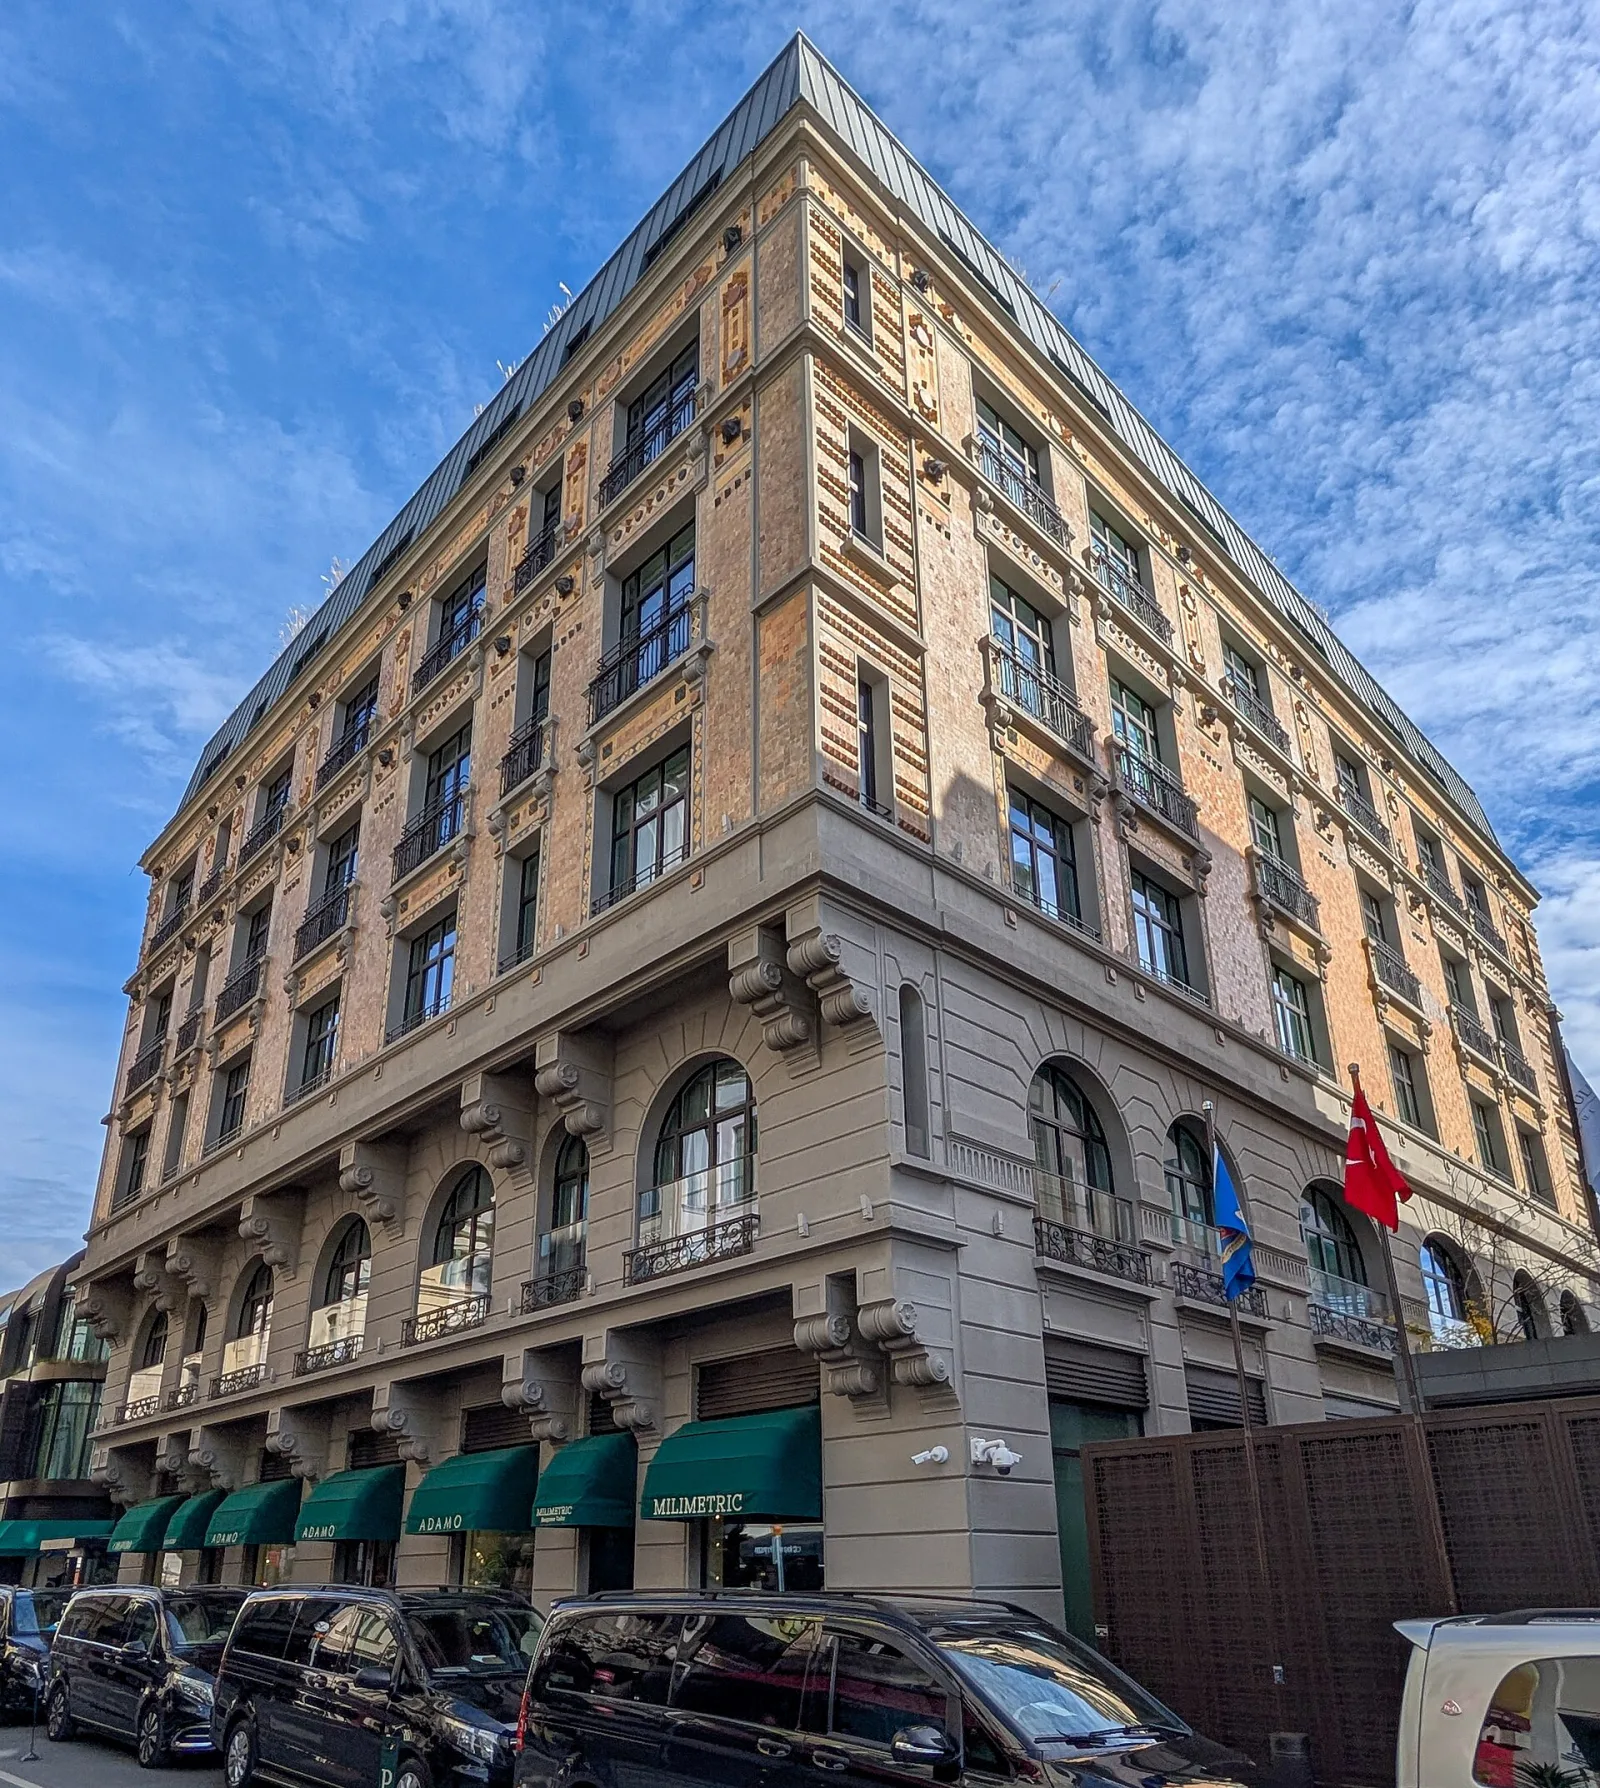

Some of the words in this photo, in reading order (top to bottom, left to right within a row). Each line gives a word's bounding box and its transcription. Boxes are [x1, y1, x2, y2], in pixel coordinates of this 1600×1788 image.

[653, 1493, 743, 1515] MILIMETRIC
[301, 1524, 336, 1539] ADAMO
[418, 1514, 462, 1532] ADAMO
[210, 1531, 239, 1544] ADAMO
[381, 1768, 393, 1788] P
